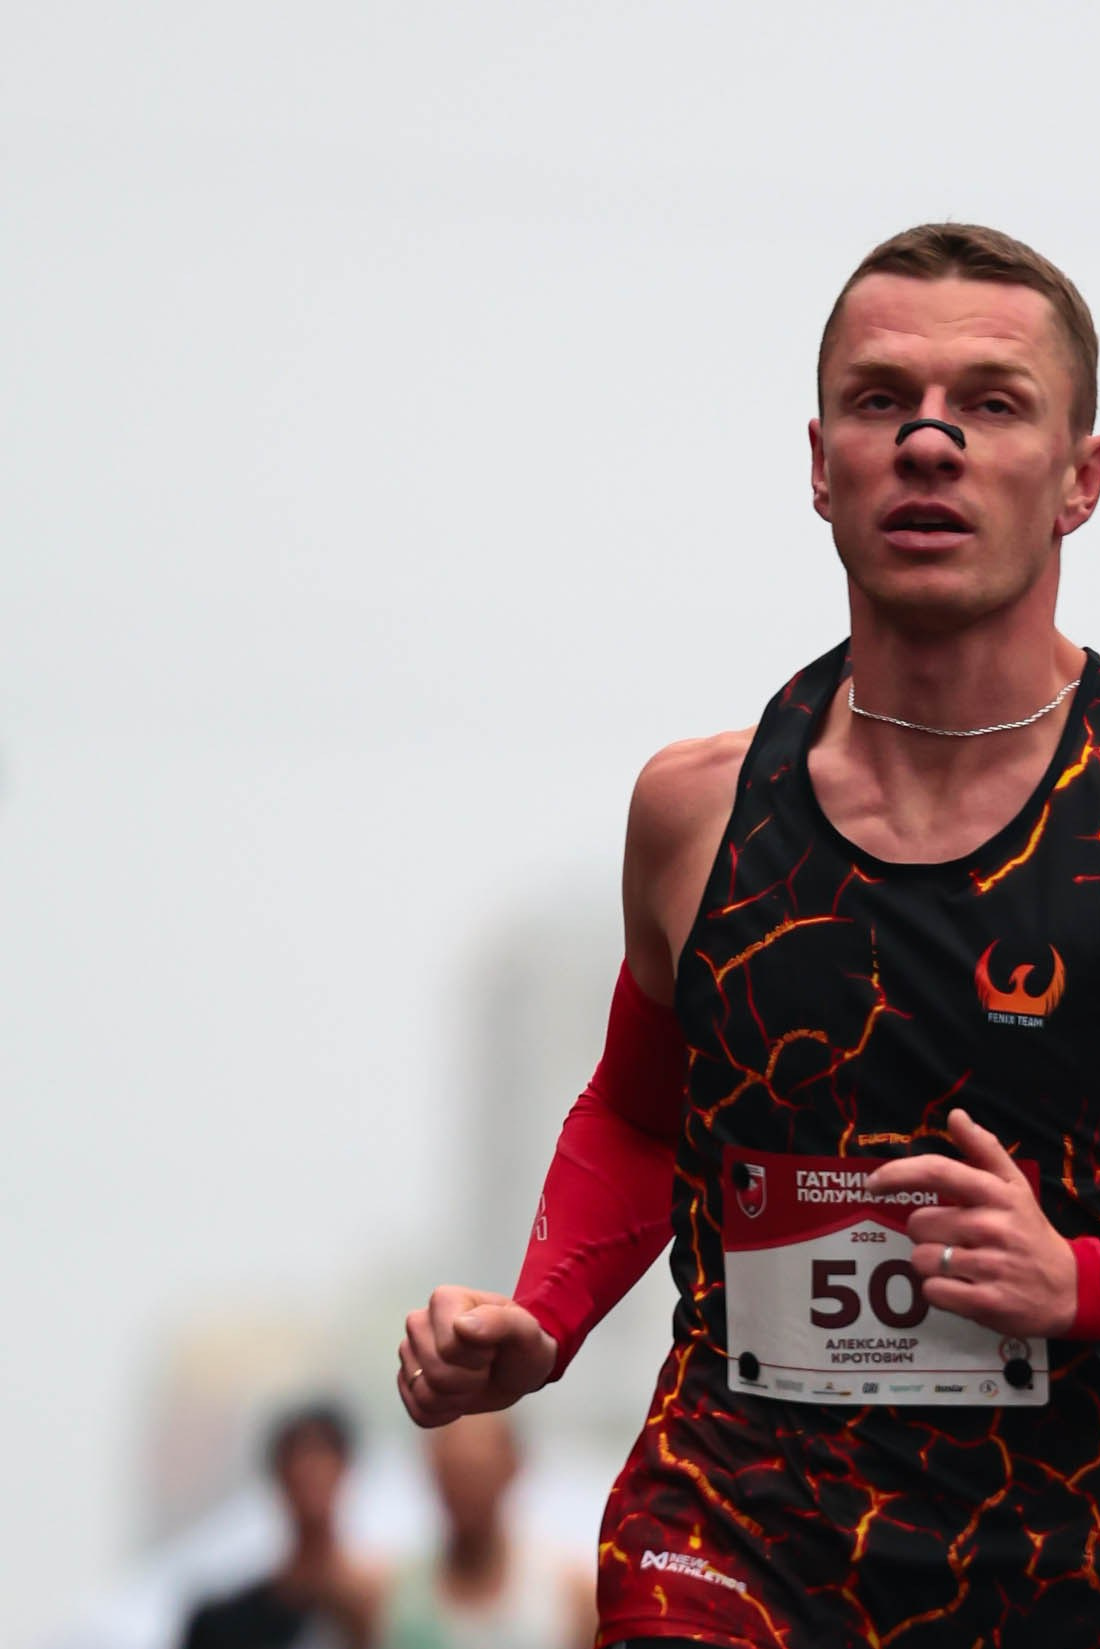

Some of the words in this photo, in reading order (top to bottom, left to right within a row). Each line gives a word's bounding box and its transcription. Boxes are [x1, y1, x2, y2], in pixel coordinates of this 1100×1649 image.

[987, 1012, 1015, 1024] FENIX
[1017, 1015, 1043, 1027] TEAM
[851, 1232, 887, 1243] 2025
[810, 1259, 930, 1330] 50
[825, 1338, 919, 1350] АЛЕКСАНДР
[831, 1352, 914, 1364] КРОТОВИЧ
[669, 1552, 709, 1568] NEW
